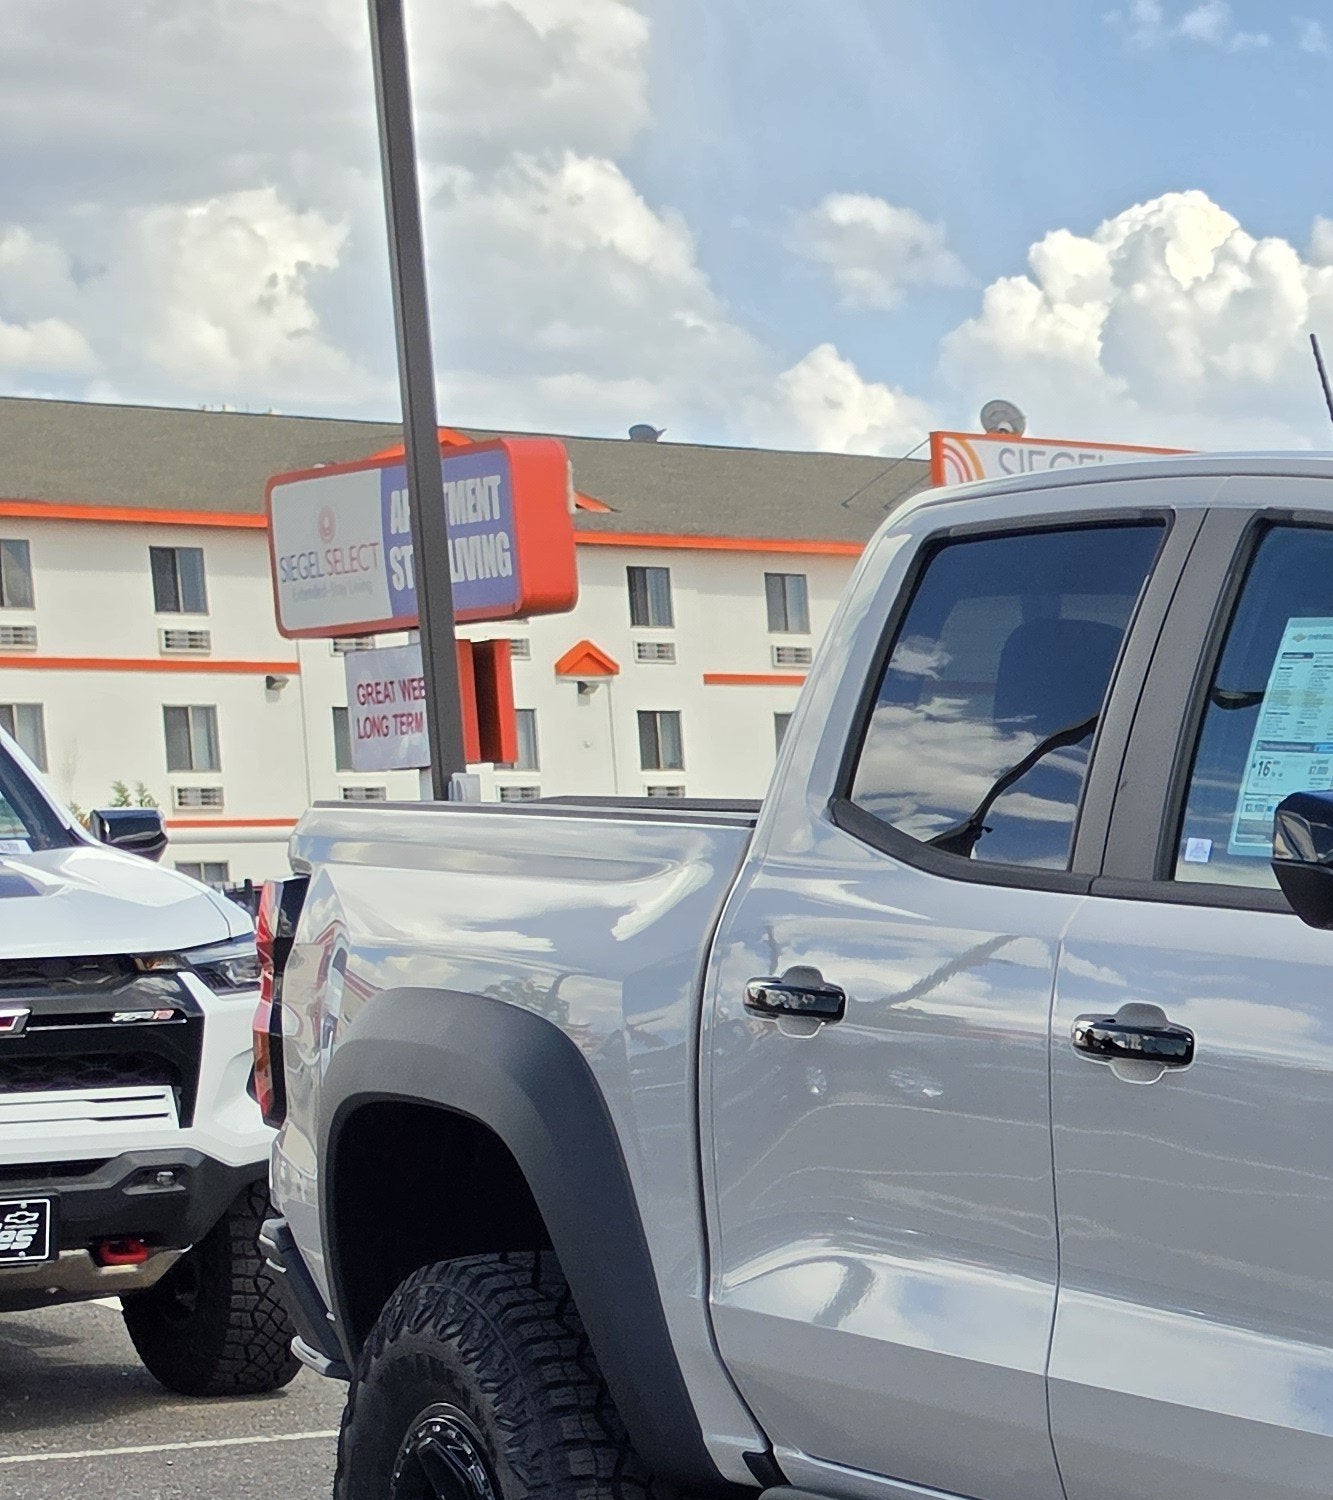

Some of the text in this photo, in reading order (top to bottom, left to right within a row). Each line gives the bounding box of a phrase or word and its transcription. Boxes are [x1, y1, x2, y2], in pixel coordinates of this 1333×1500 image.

[280, 551, 325, 582] SIEGEL
[325, 542, 379, 575] SELECT
[356, 680, 395, 706] GREAT
[357, 711, 424, 739] LONG TERM
